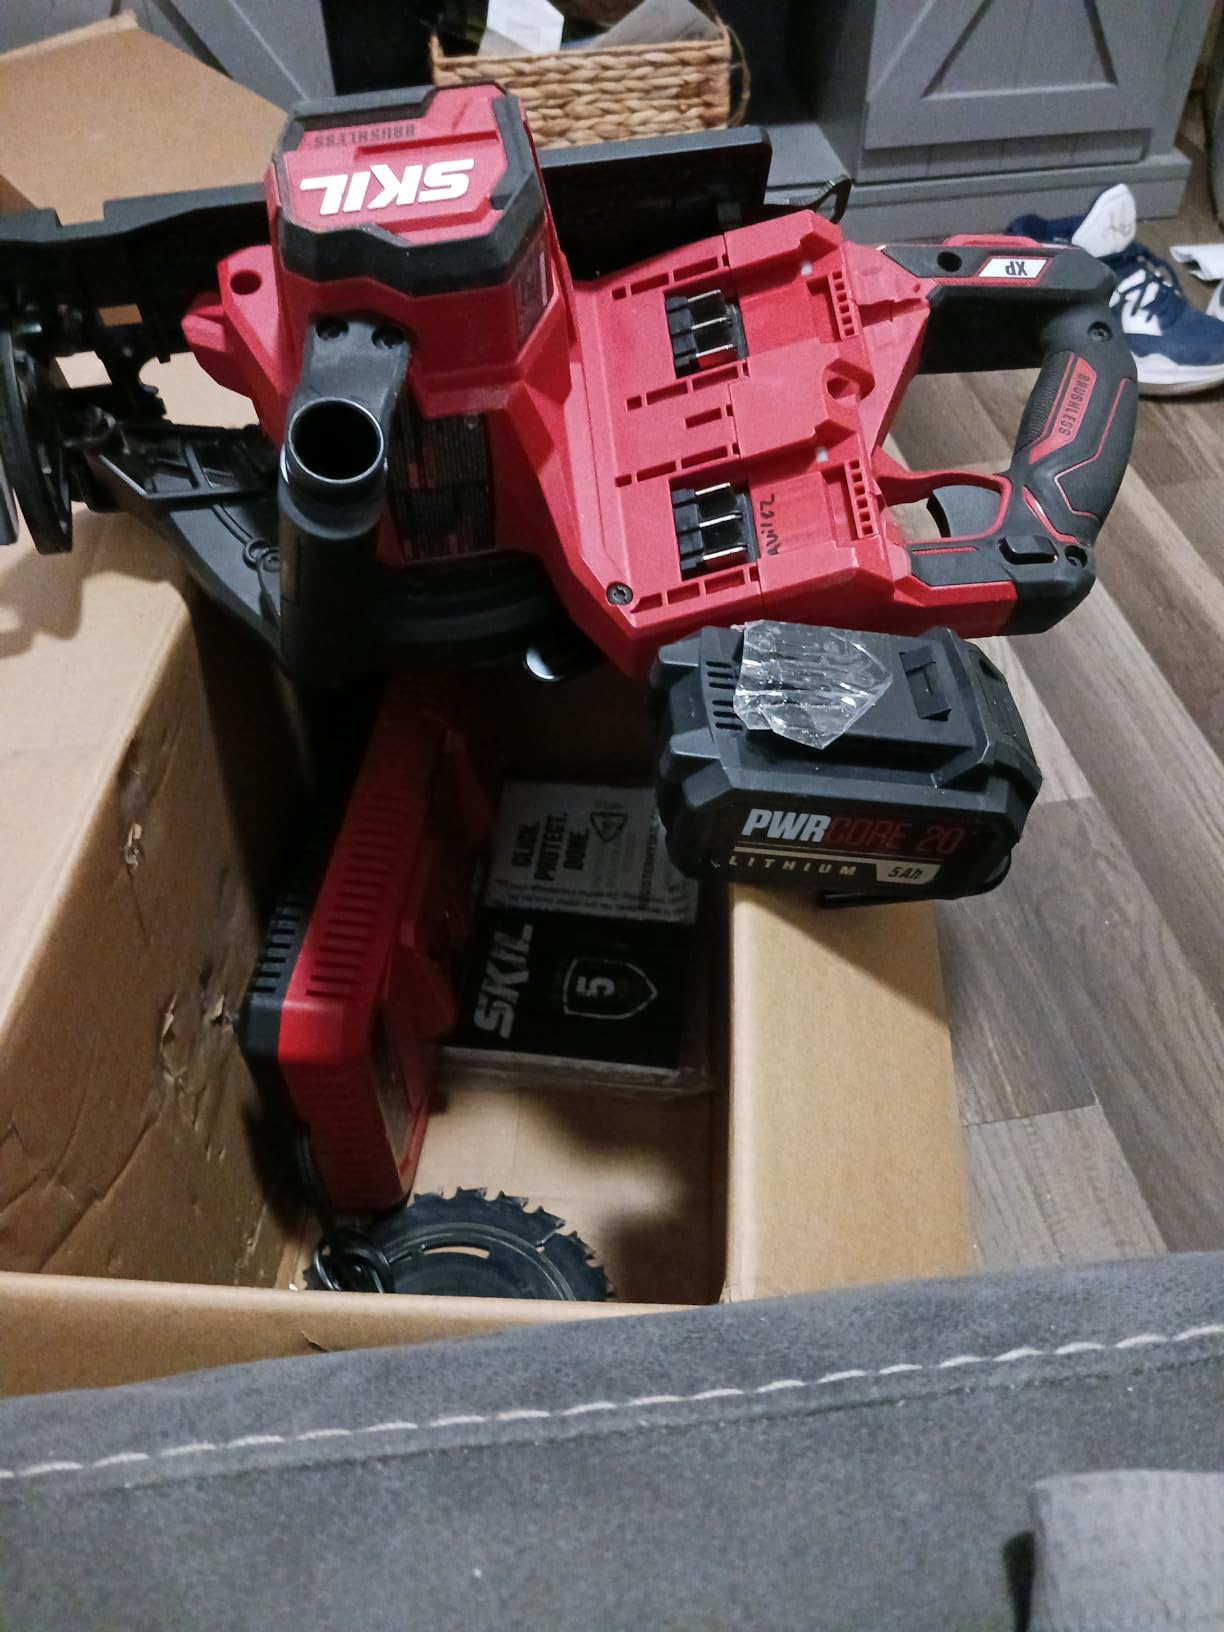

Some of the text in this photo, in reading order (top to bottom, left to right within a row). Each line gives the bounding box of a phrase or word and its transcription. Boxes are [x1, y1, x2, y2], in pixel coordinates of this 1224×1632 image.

[314, 125, 416, 148] BRUSHLESS
[300, 159, 474, 214] SKIL
[1005, 261, 1027, 276] XP
[1058, 373, 1090, 436] BRUSHLESS
[915, 827, 964, 855] 20
[728, 855, 857, 875] LITHIUM
[887, 868, 923, 880] 5Ah
[475, 922, 534, 1039] SKIL
[575, 975, 615, 999] 5
